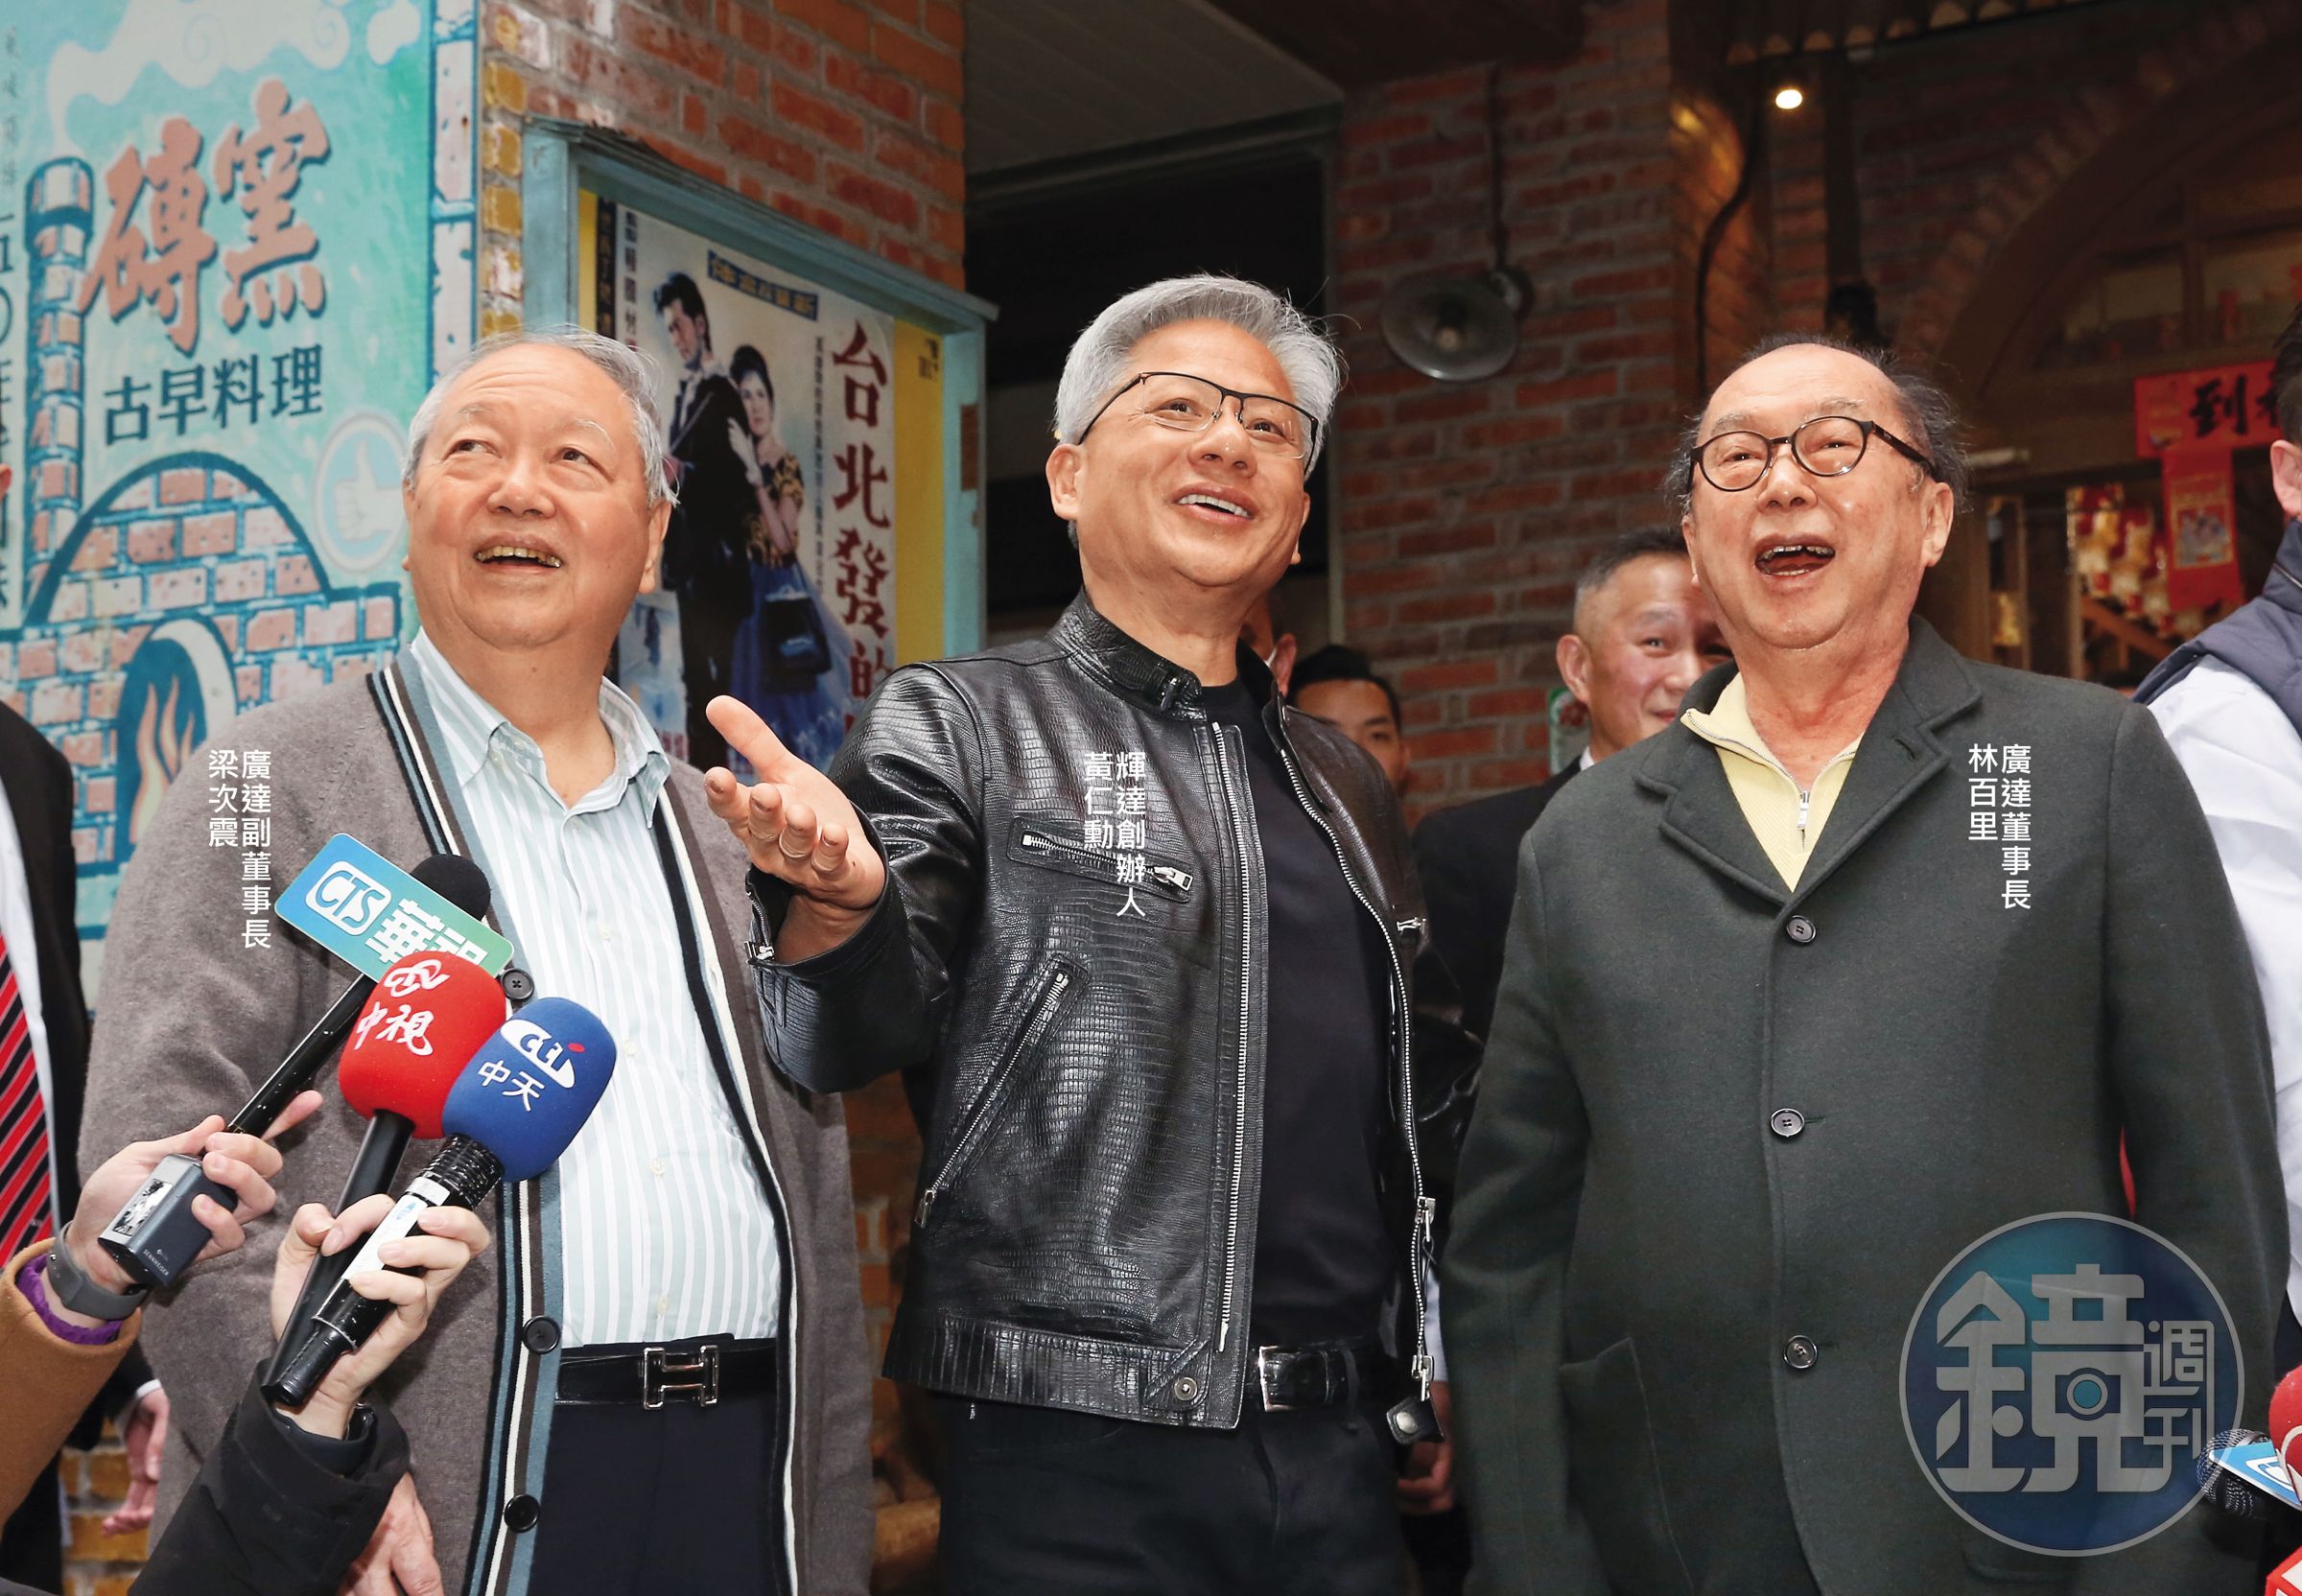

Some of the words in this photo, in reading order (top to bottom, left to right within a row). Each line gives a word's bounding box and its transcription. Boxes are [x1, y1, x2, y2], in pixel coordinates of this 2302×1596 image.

[104, 342, 324, 446] 古早料理
[833, 320, 892, 735] 台北發的
[315, 869, 387, 929] CTS
[354, 1000, 435, 1056] 中視
[478, 1059, 545, 1112] 中天
